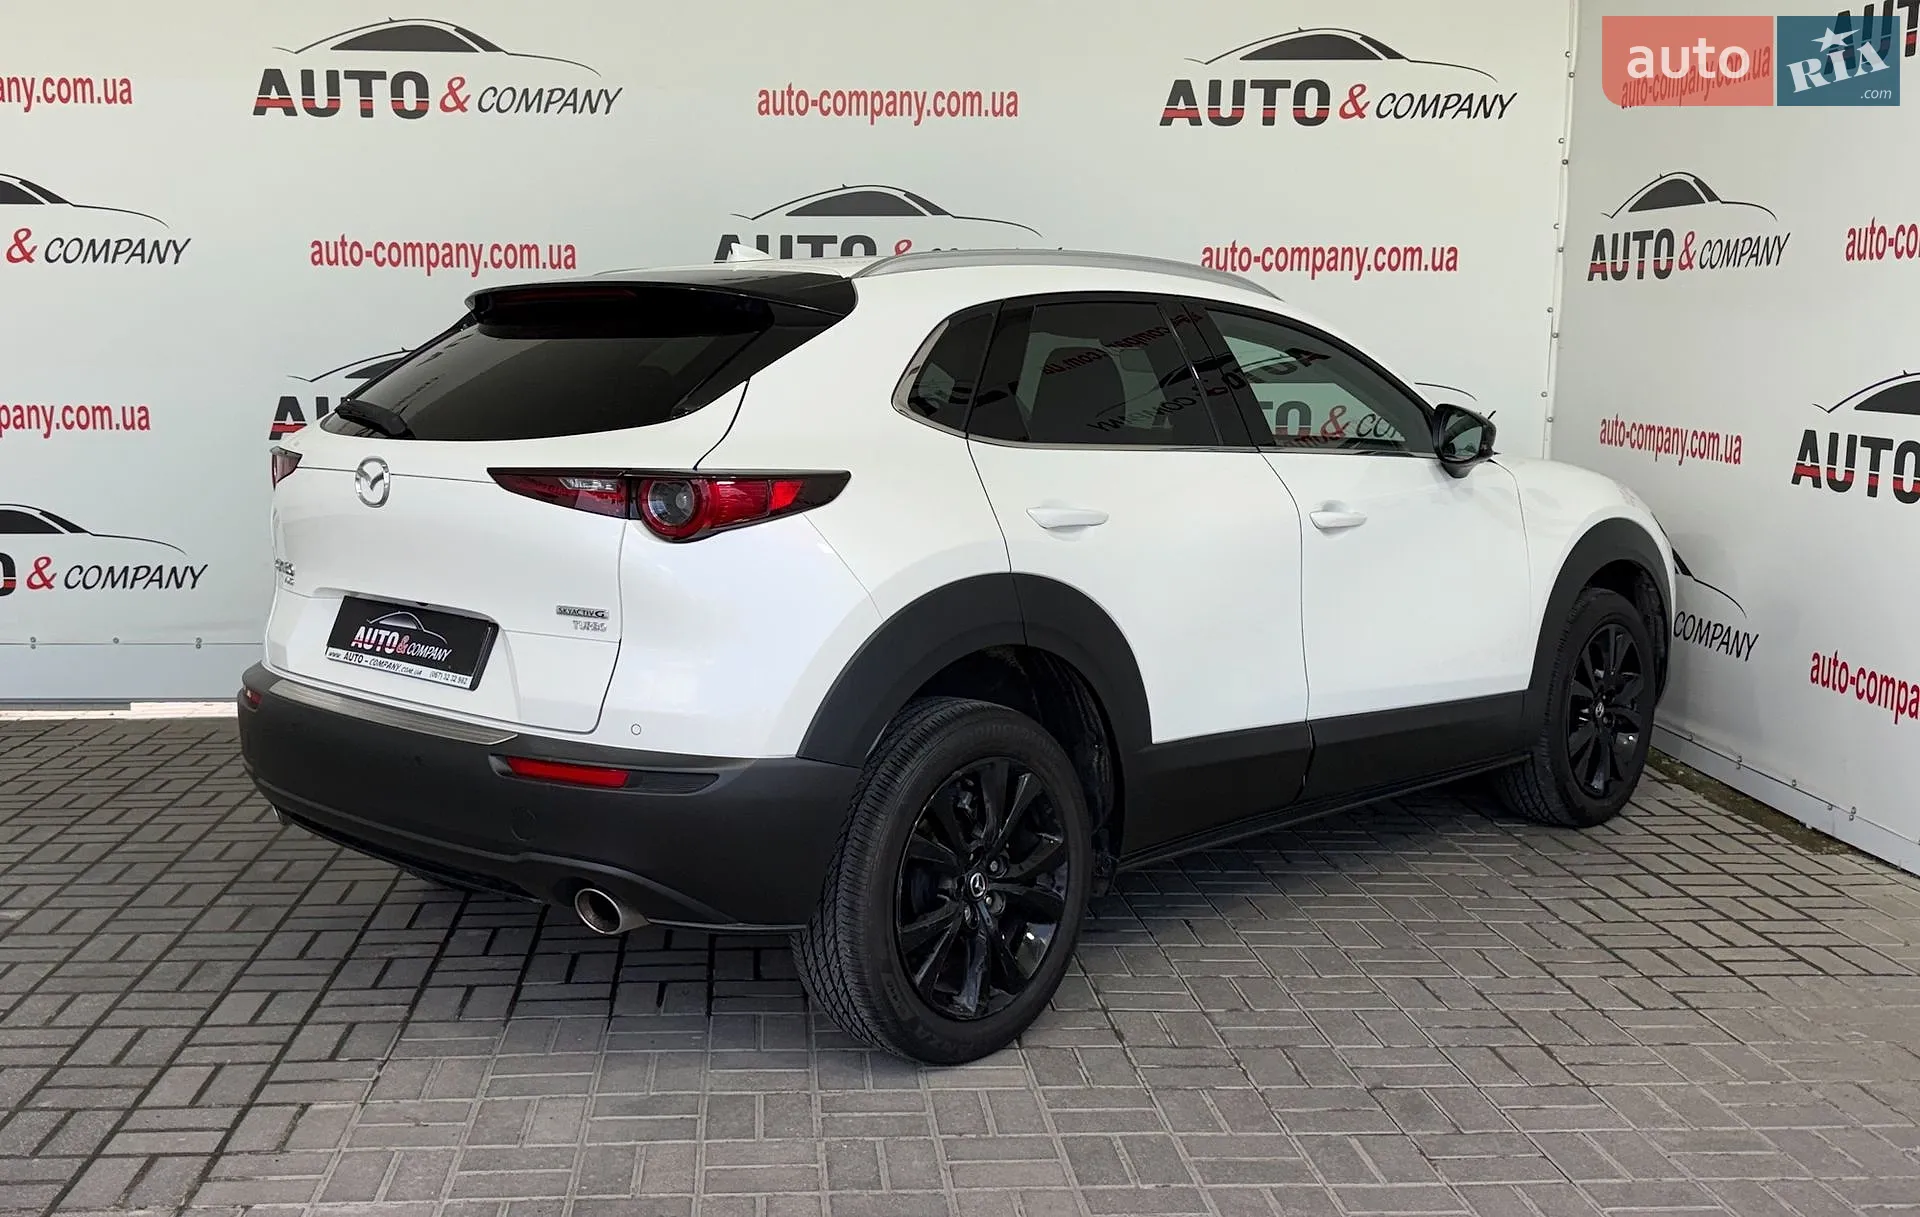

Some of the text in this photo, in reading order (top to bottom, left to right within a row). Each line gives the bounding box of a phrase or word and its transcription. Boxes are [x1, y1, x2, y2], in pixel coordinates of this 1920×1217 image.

[252, 69, 623, 119] AUTO & COMPANY
[757, 82, 1019, 126] auto-company.com.ua
[1159, 79, 1518, 126] AUTO & COMPANY
[6, 228, 191, 265] & COMPANY
[310, 233, 577, 277] auto-company.com.ua
[1201, 240, 1459, 281] auto-company.com.ua
[1587, 228, 1791, 281] AUTO & COMPANY
[1846, 216, 1920, 261] auto-co
[1600, 413, 1742, 466] auto-company.com.ua
[1791, 429, 1920, 504] AUTO
[26, 556, 57, 590] &
[64, 564, 208, 590] COMPANY
[351, 626, 453, 662] AUTO & COMPANY
[1673, 610, 1760, 662] COMPANY
[1810, 650, 1920, 725] auto-compa
